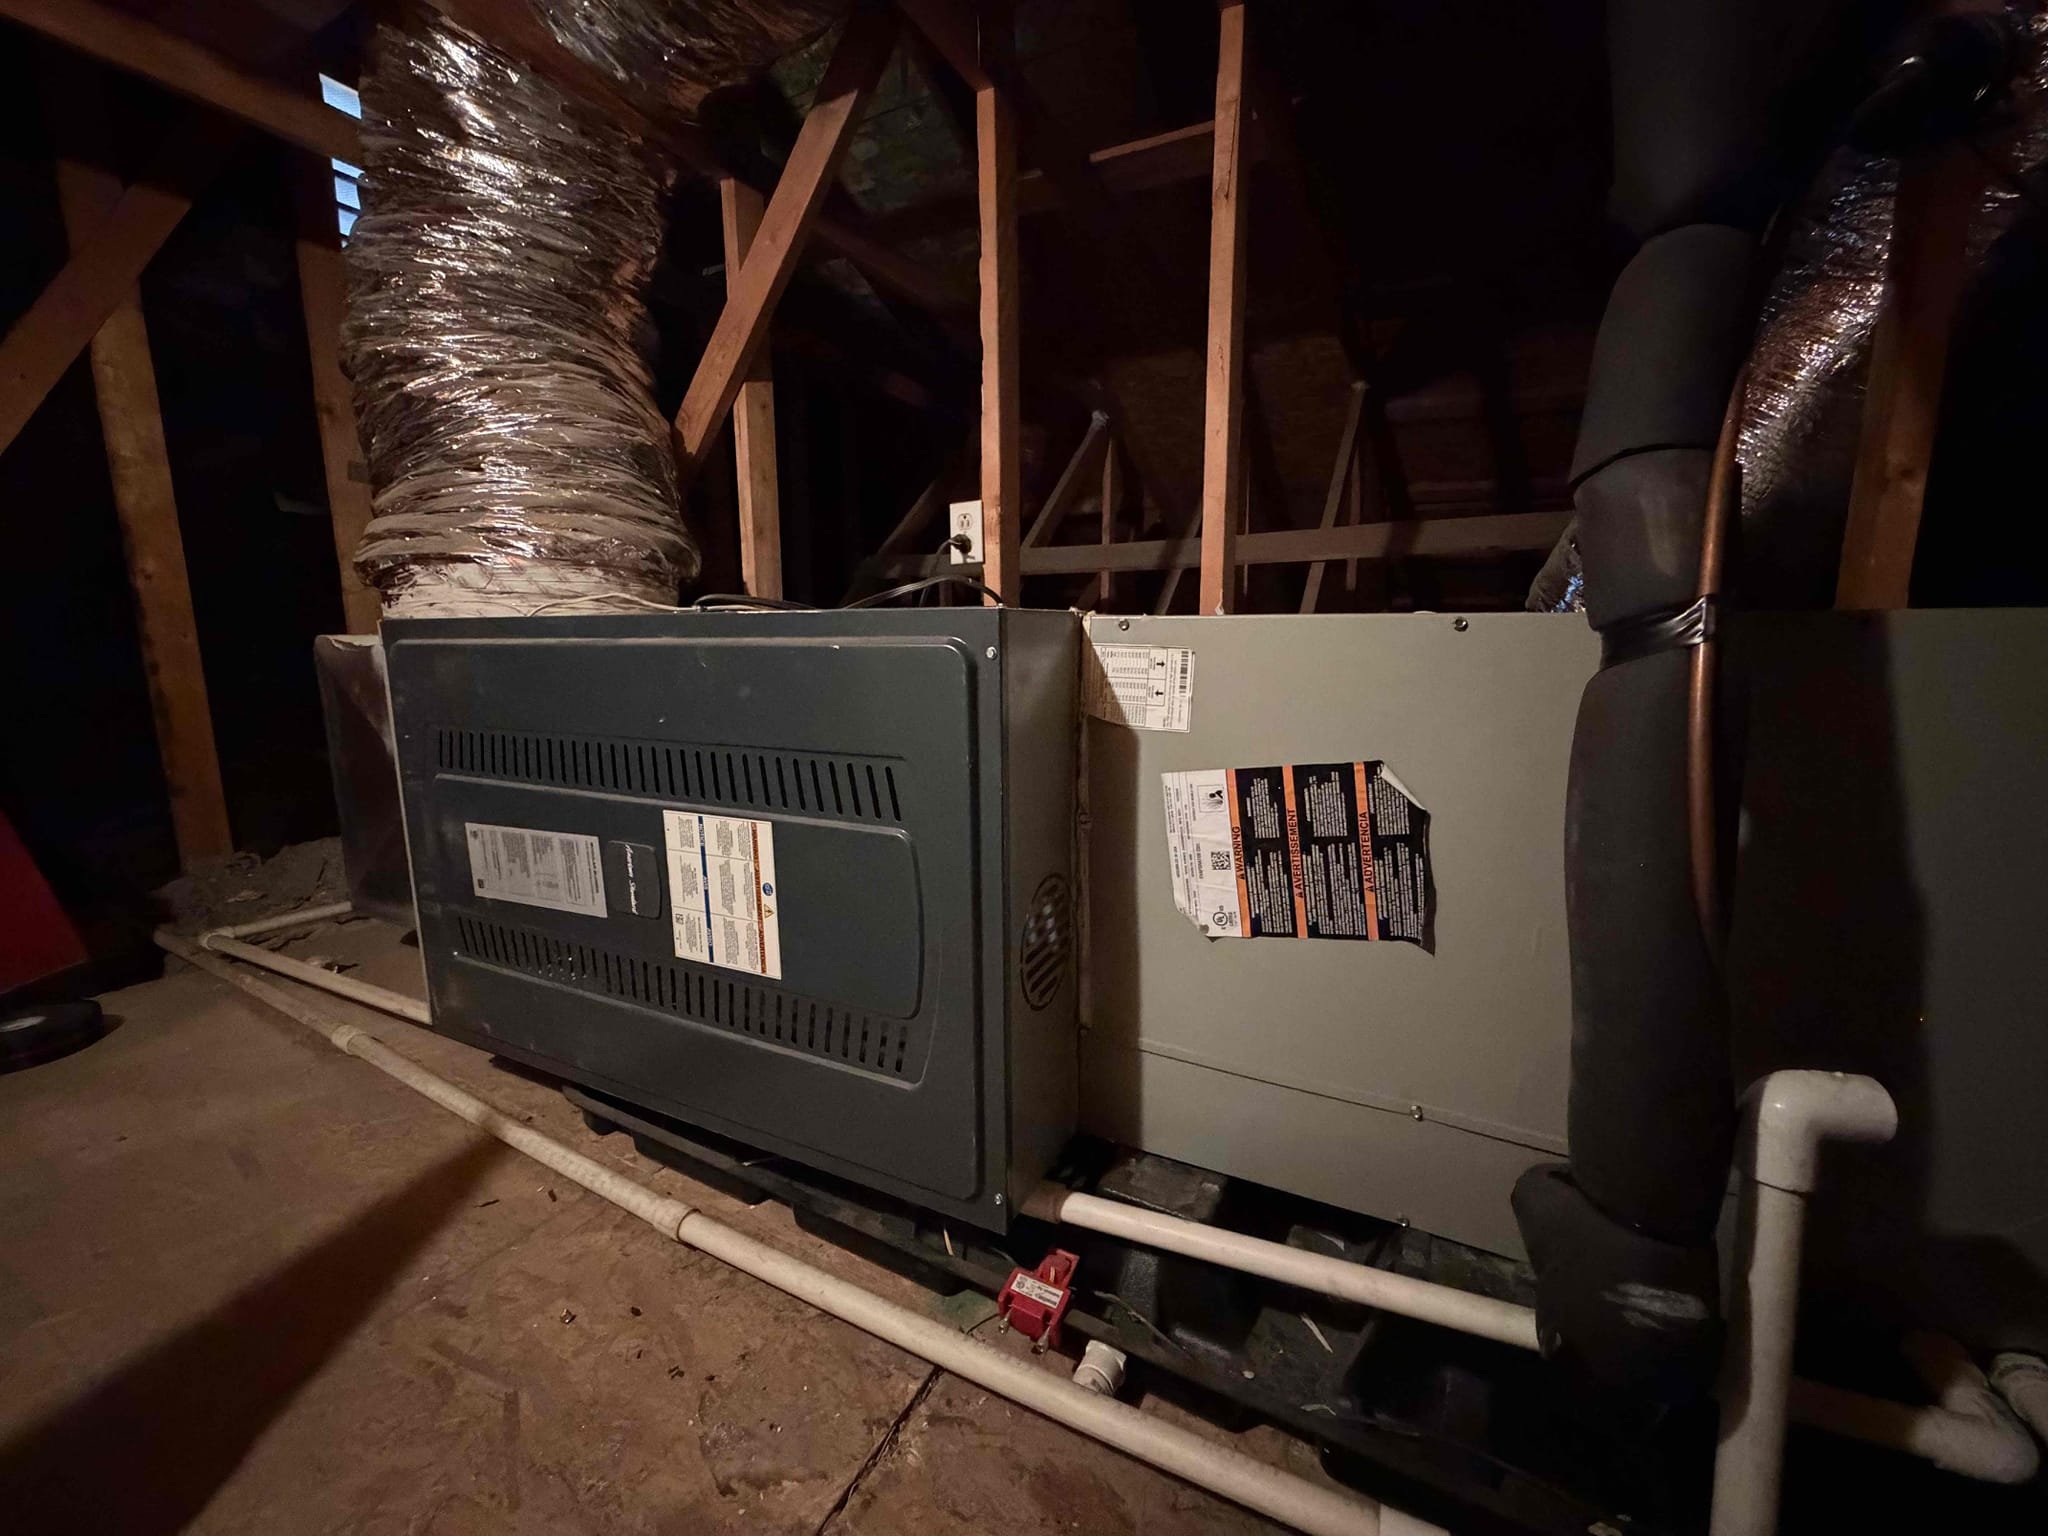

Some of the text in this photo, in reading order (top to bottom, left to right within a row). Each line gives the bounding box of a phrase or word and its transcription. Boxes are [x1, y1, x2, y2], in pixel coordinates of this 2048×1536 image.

[1232, 826, 1245, 873] WARNING
[1287, 809, 1303, 890] AVERTISSEMENT
[1359, 811, 1374, 886] ADVERTENCIA
[628, 880, 639, 915] Standard
